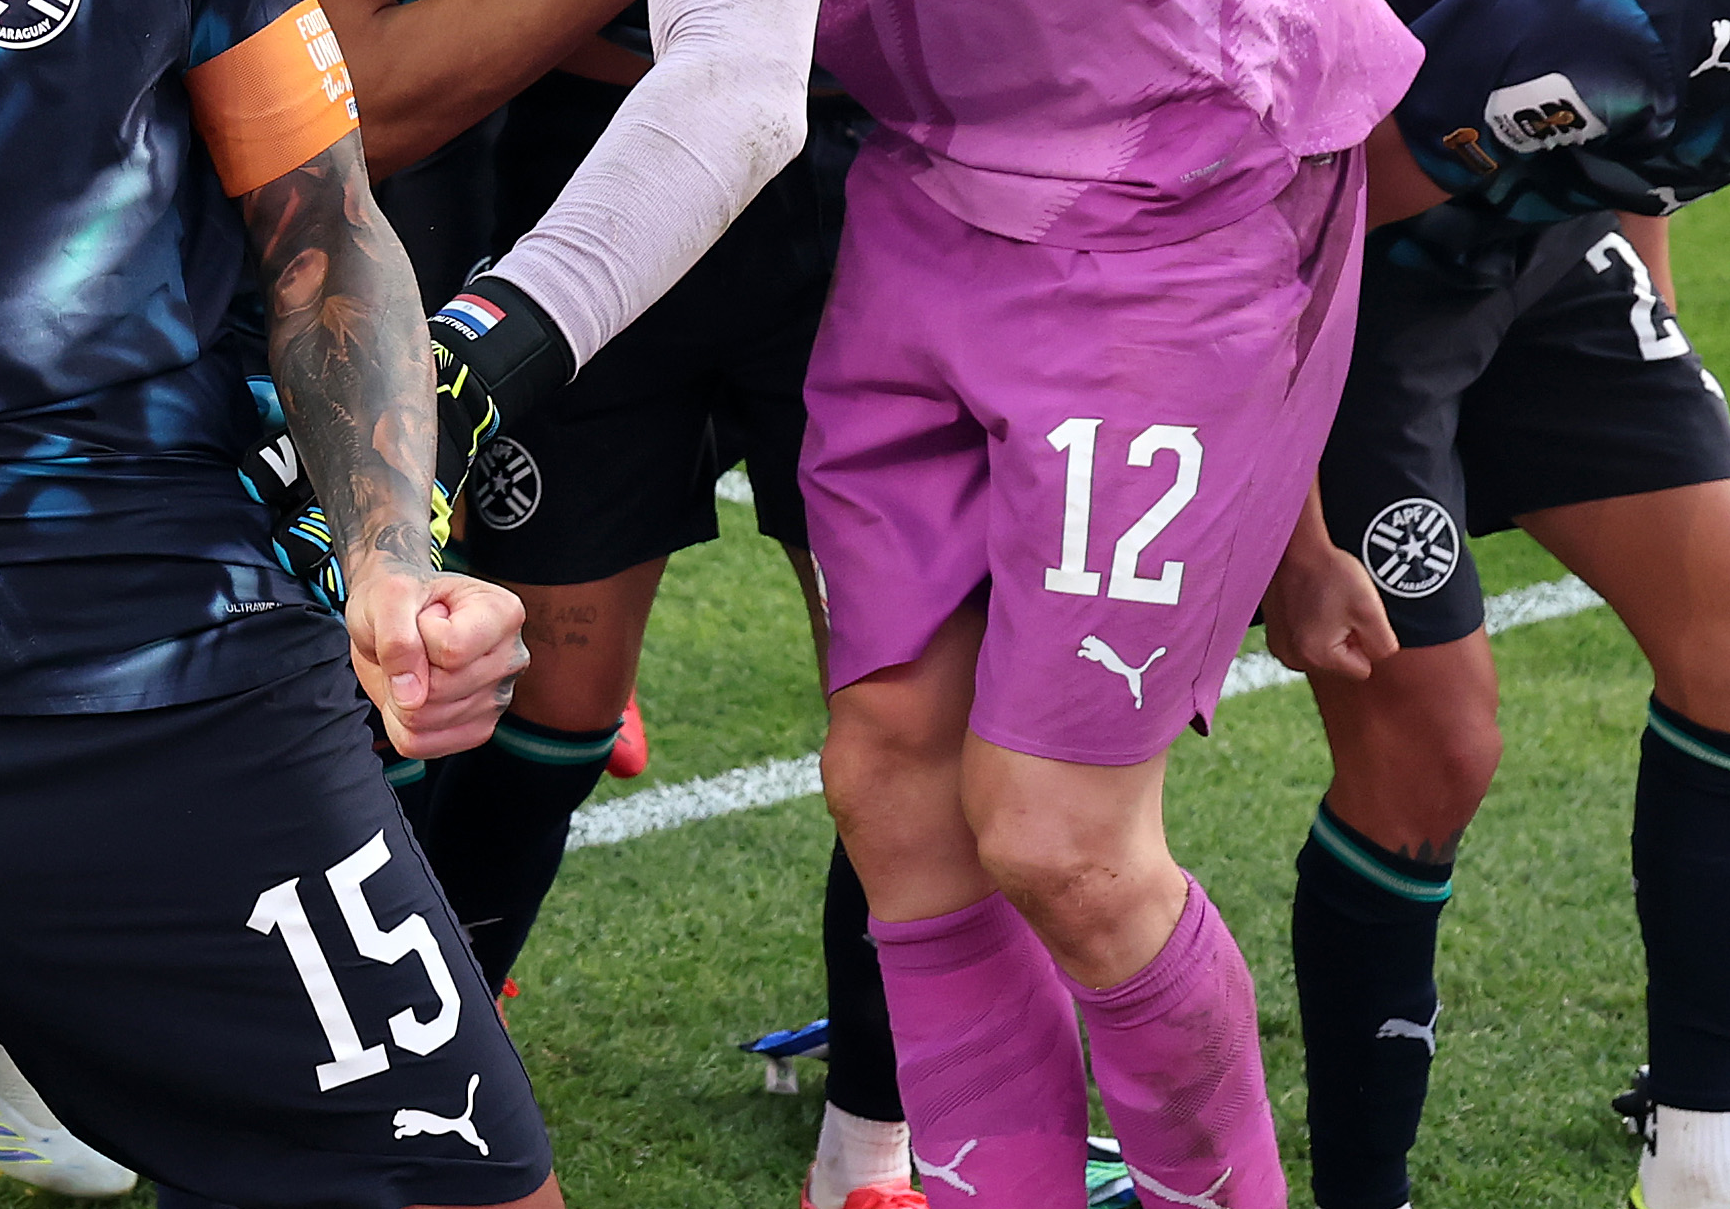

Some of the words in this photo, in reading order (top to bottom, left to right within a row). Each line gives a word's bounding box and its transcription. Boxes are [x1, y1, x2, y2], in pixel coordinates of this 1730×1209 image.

[1044, 417, 1205, 606] 12
[1392, 505, 1423, 528] APF
[245, 828, 461, 1092] 15
